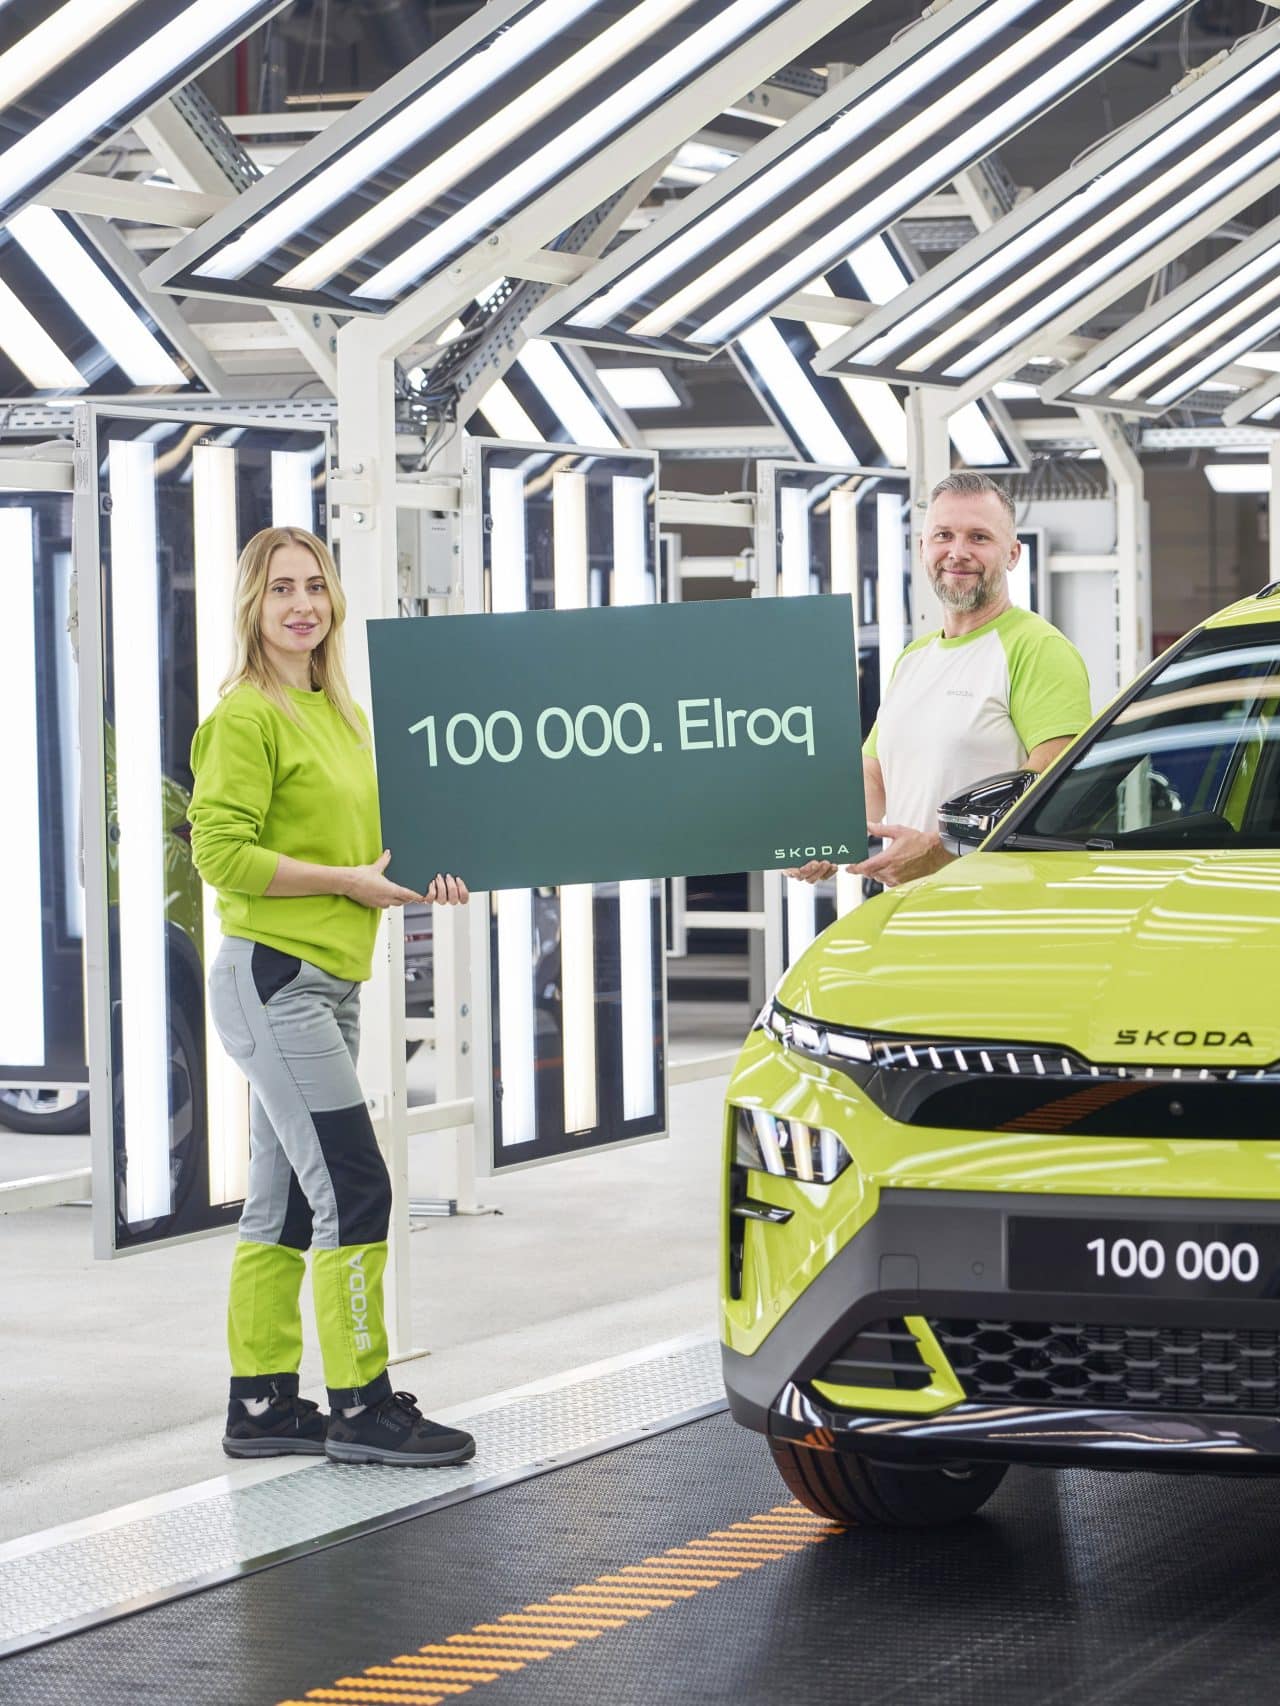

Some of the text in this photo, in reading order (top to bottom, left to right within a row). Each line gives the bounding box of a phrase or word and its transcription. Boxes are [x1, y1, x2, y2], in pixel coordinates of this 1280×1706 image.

[408, 697, 816, 767] 100 000. Elroq
[1086, 1237, 1260, 1282] 100 000
